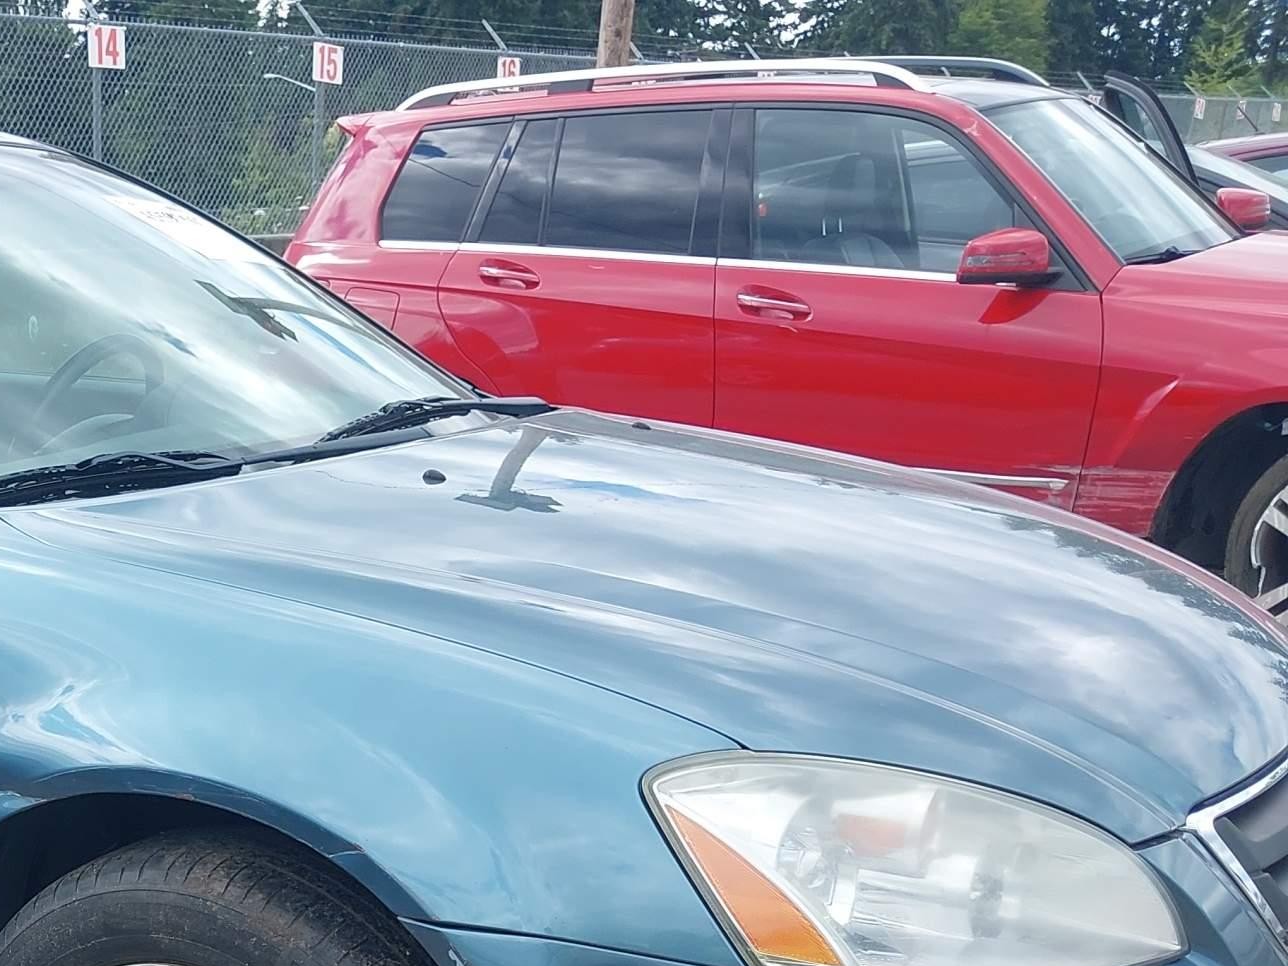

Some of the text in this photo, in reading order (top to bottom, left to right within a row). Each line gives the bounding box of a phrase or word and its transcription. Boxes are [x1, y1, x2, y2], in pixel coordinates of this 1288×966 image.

[95, 27, 119, 66] 14
[319, 45, 338, 81] 15
[502, 59, 516, 77] 16
